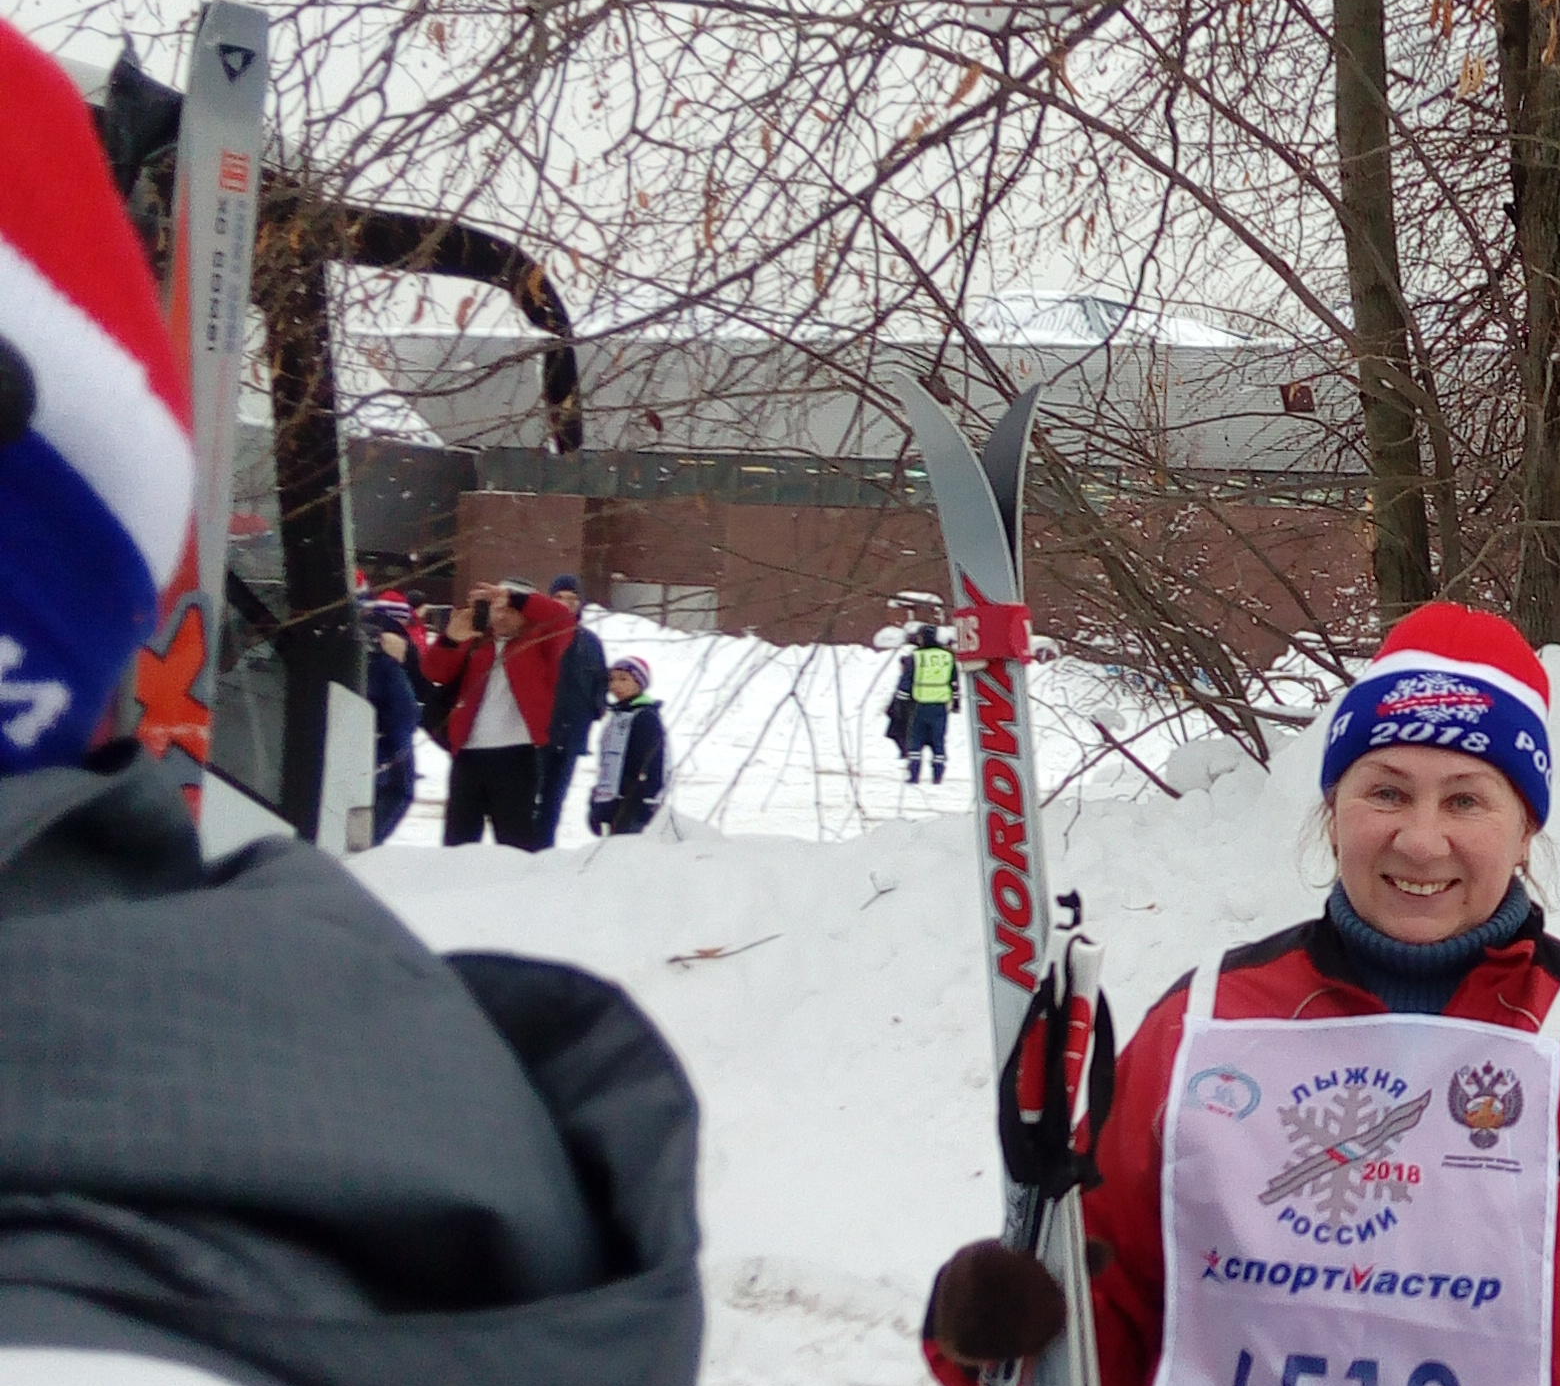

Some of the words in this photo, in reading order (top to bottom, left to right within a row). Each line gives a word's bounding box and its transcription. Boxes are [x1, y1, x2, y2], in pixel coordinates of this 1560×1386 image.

[1369, 721, 1491, 753] 2018
[1292, 1065, 1410, 1105] ЛЫЖНЯ
[1361, 1160, 1421, 1185] 2018
[1278, 1206, 1399, 1246] РОССИИ
